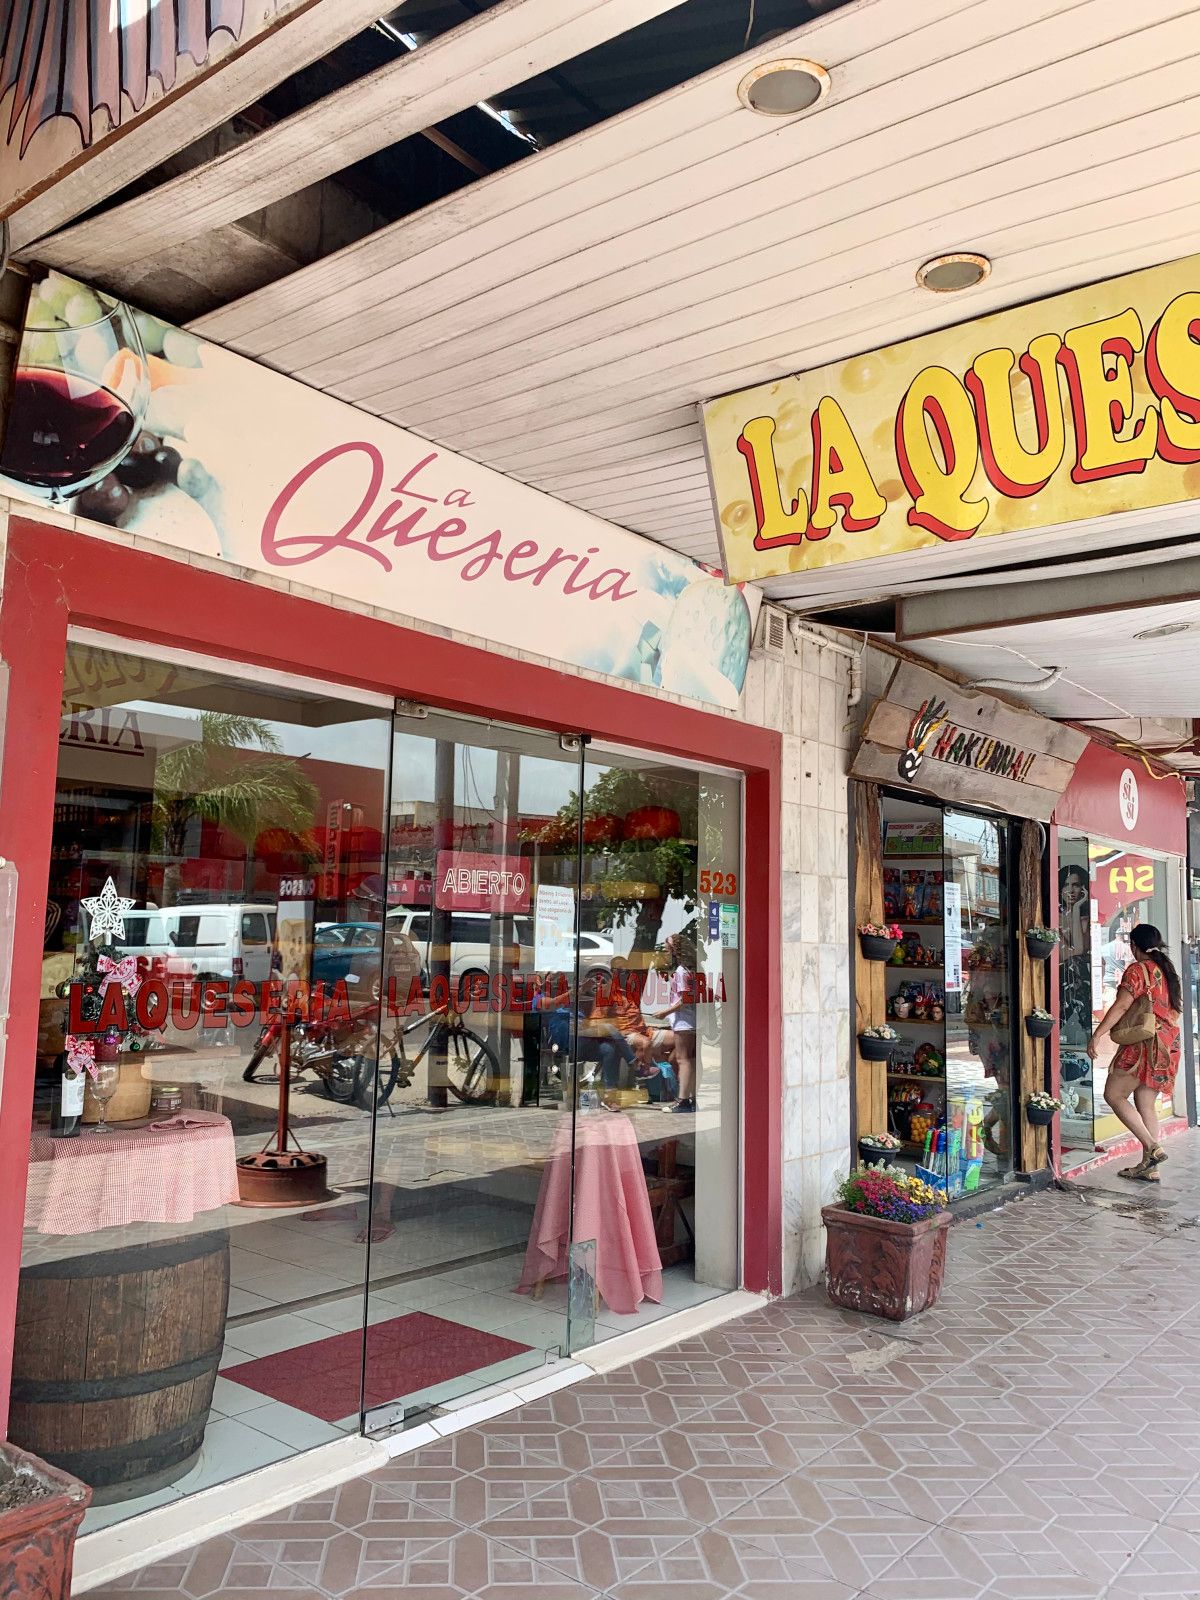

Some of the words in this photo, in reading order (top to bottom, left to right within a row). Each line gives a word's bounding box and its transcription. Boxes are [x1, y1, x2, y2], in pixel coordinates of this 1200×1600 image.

[737, 395, 888, 551] LA
[895, 291, 1200, 542] QUES
[391, 452, 475, 508] La
[260, 441, 637, 602] Queseria
[442, 868, 526, 896] ABIERTO
[700, 870, 737, 896] 523
[69, 981, 129, 1035] LA
[136, 977, 351, 1034] QUESERIA
